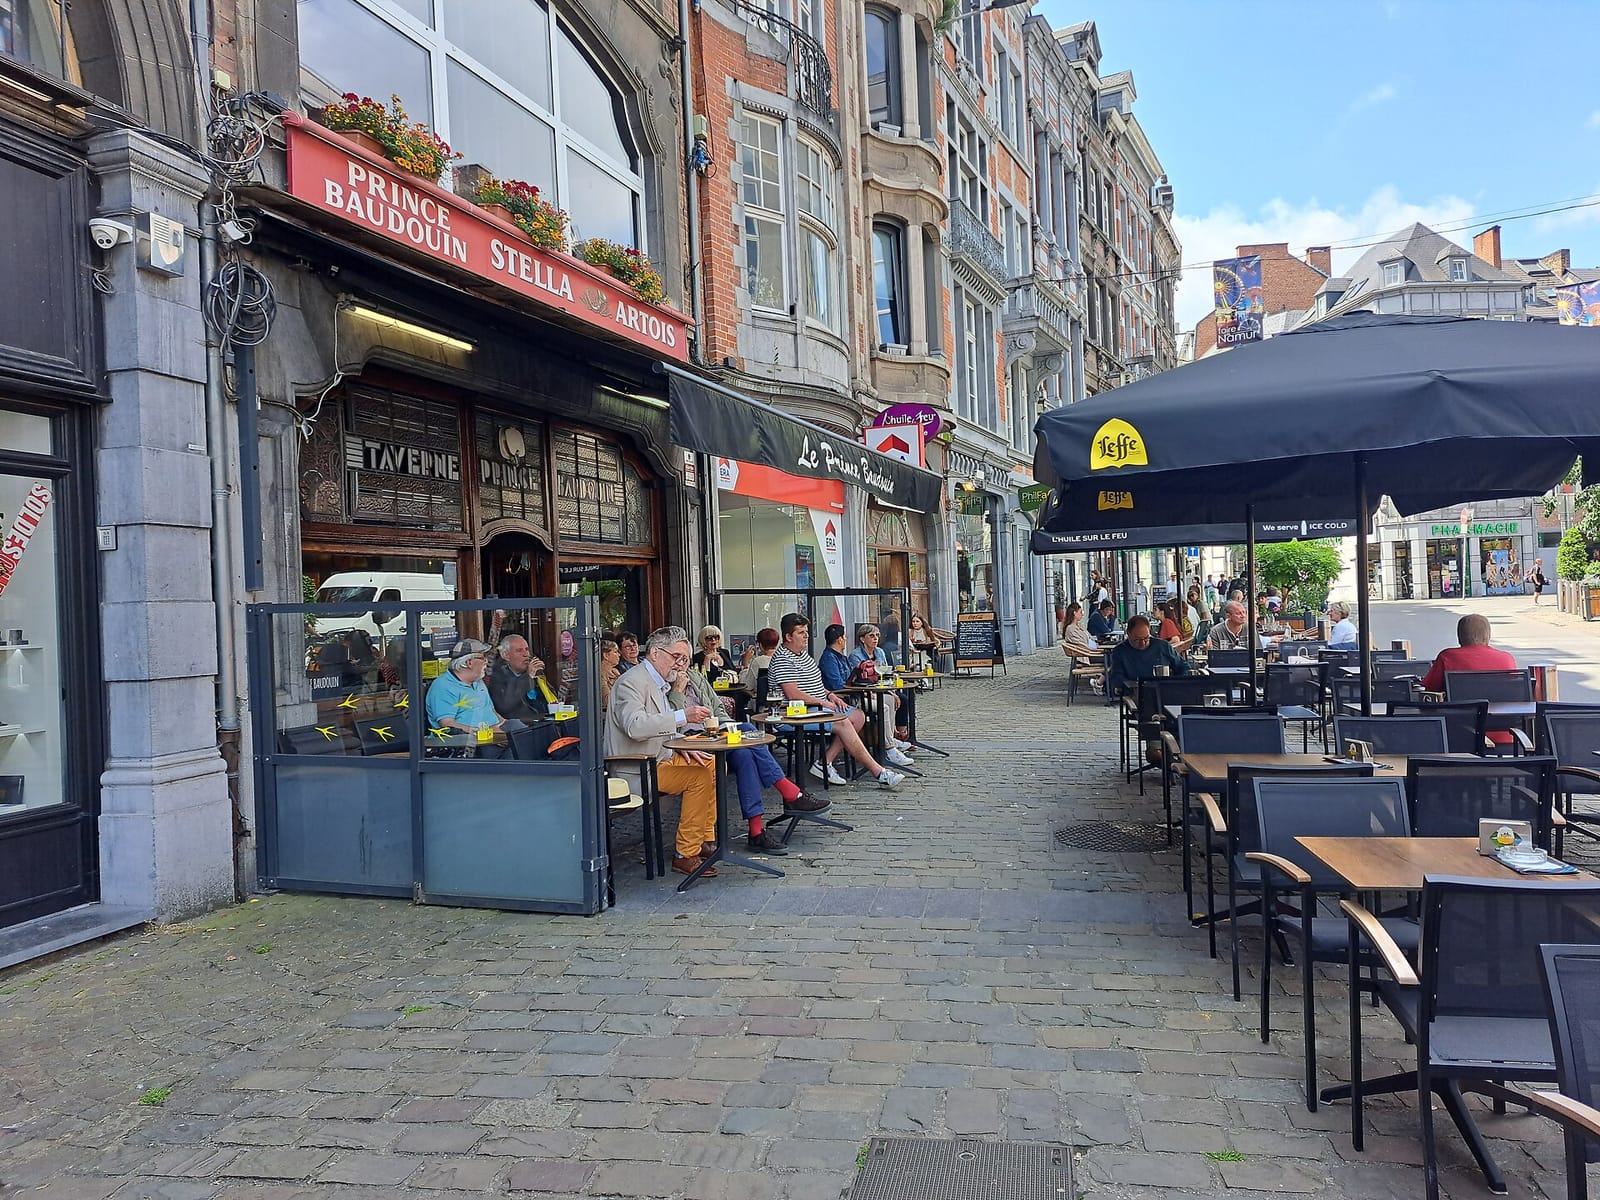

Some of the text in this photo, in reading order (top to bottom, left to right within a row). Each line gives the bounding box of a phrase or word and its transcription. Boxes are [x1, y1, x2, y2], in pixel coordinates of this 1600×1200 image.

[347, 160, 451, 232] PRINCE
[324, 178, 467, 264] BAUDOUIN
[490, 239, 676, 347] STELLA ARTOIS
[1218, 330, 1258, 344] Namur
[364, 441, 459, 481] TAVERNE
[480, 459, 540, 490] PRINCE
[798, 436, 895, 495] Le Prince Baudouin
[1097, 433, 1137, 461] Leffe
[719, 467, 731, 476] ERA
[1021, 491, 1048, 501] PhilFa
[2, 483, 52, 560] SOLDES
[1051, 535, 1081, 543] L'HUILE
[1100, 533, 1111, 541] LE
[1112, 532, 1128, 540] FEU
[826, 537, 837, 548] ERA
